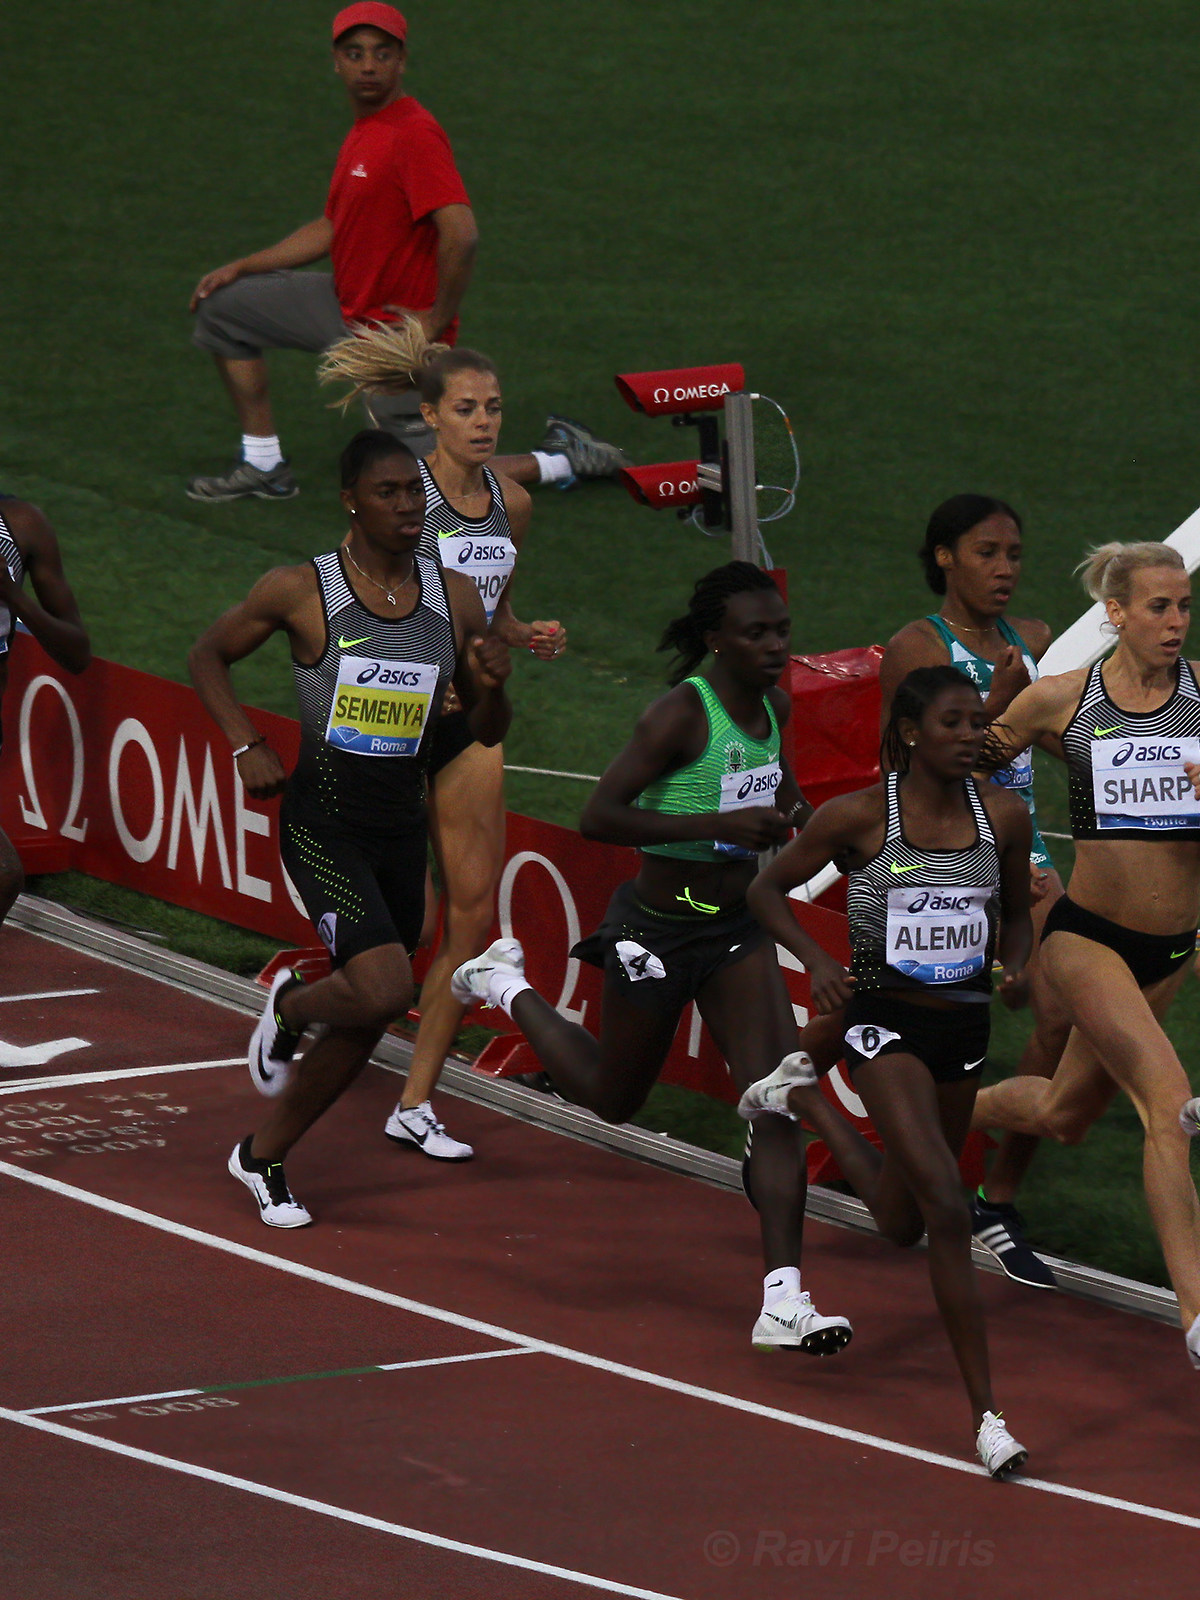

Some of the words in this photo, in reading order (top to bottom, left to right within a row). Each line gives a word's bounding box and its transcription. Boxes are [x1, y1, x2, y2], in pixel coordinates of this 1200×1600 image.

[673, 383, 731, 401] OMEGA
[474, 546, 506, 561] asics
[379, 669, 421, 686] asics
[335, 695, 424, 727] SEMENYA
[370, 738, 407, 752] Roma
[1135, 746, 1181, 761] asics
[753, 773, 778, 793] asics
[1104, 776, 1192, 805] SHARP
[109, 718, 310, 920] OME
[930, 896, 975, 910] asics
[894, 921, 983, 951] ALEMU
[629, 951, 652, 977] 4
[934, 964, 974, 980] Roma
[861, 1026, 880, 1052] 6
[128, 1397, 241, 1417] 800
